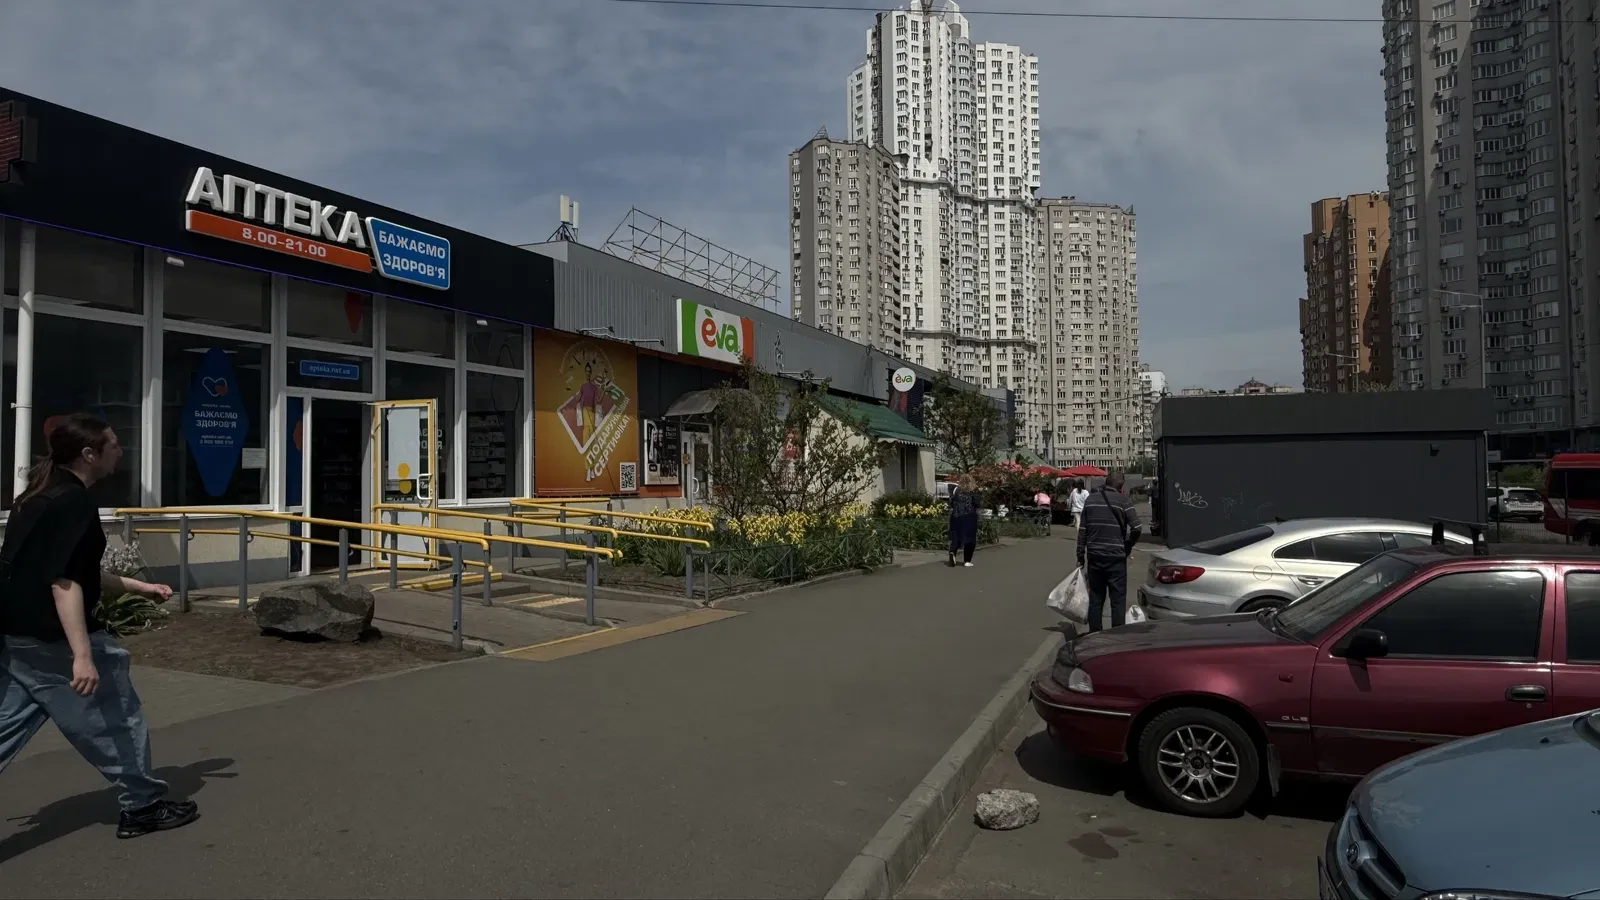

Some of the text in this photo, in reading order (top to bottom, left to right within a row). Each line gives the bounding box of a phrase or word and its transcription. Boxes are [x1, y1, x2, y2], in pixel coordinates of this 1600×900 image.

[185, 166, 366, 248] АПТЕКА
[378, 230, 446, 259] БАЖАЄМО
[383, 254, 446, 280] ЗДОРОВ'Я
[194, 410, 238, 419] БАЖАЄМО
[195, 419, 237, 429] ЗДОРОВ'Я
[594, 414, 631, 477] СЕРТИФІКАТ
